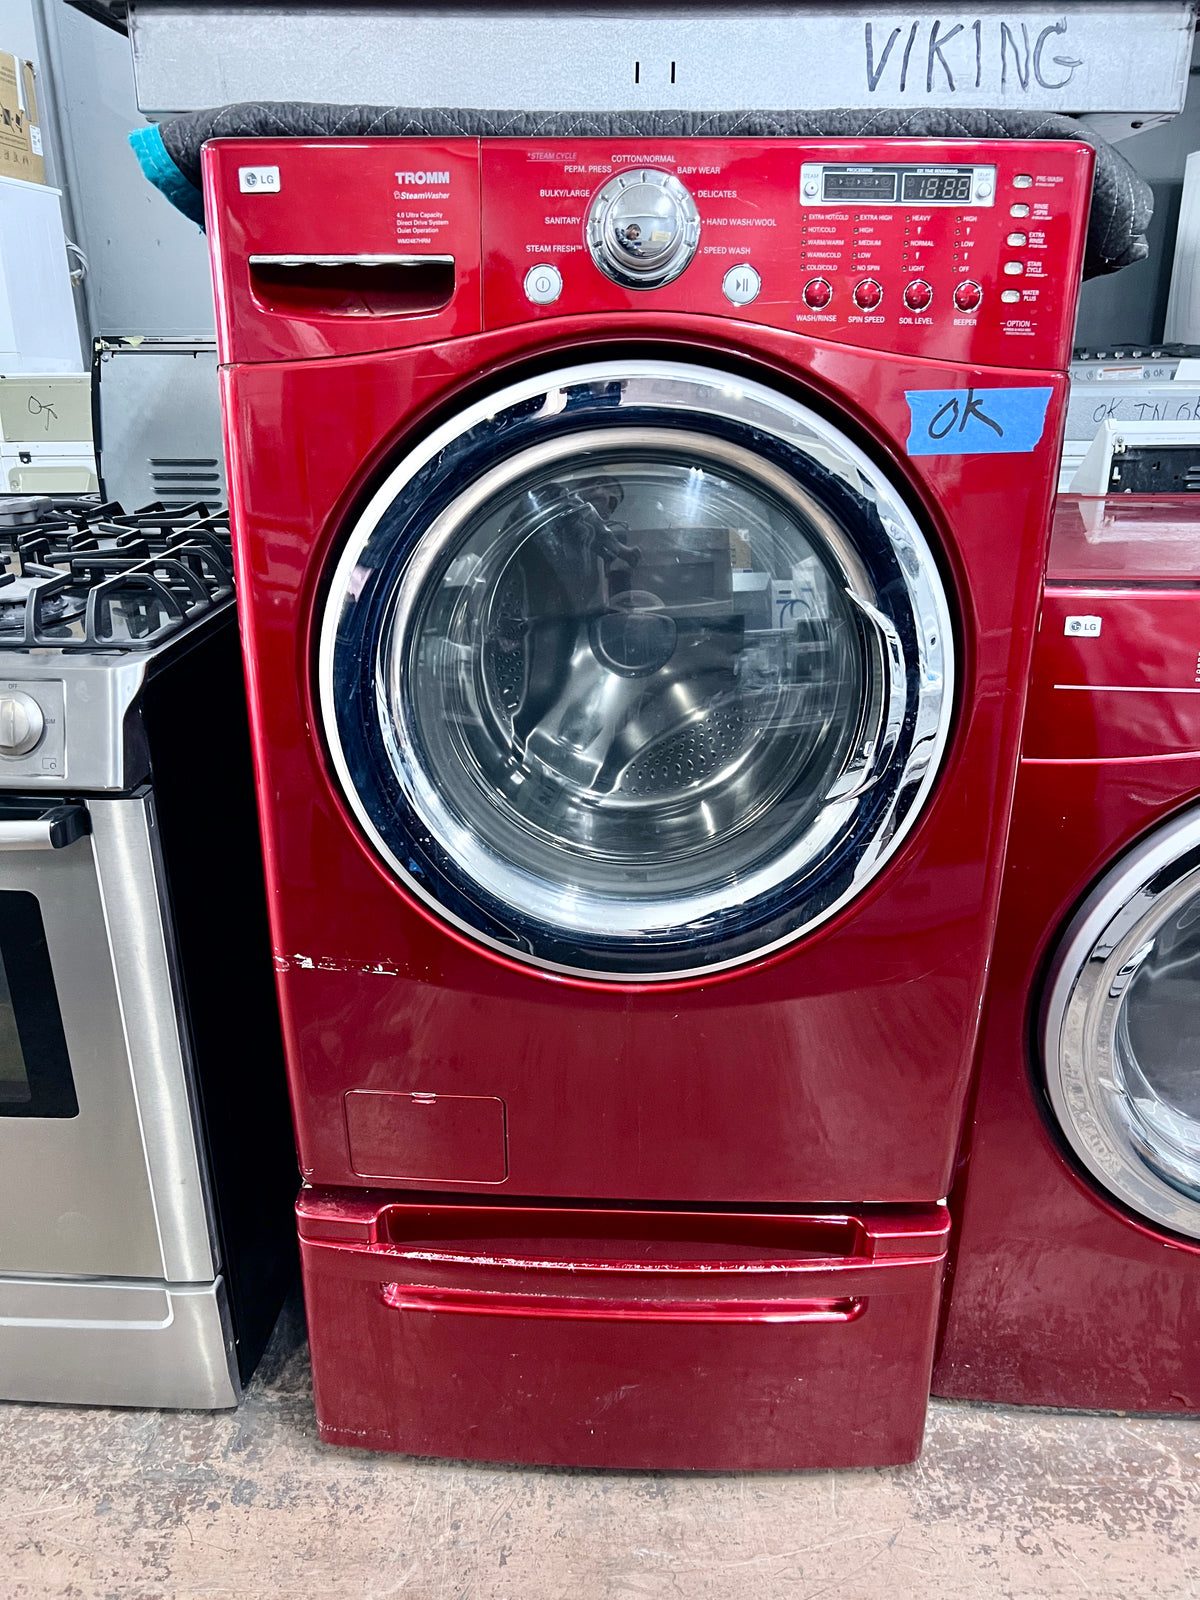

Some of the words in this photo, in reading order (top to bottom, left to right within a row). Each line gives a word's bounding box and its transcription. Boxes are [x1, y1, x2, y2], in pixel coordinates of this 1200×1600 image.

[865, 16, 1083, 93] VIKING
[556, 152, 577, 160] CYCLE
[611, 154, 676, 163] COTTON/NORMAL
[588, 165, 612, 173] PRESS
[677, 166, 697, 174] BABY
[698, 166, 721, 175] WEAR
[260, 174, 275, 185] LG
[394, 171, 450, 185] TROMM
[400, 191, 450, 200] SteamWasher
[539, 189, 590, 197] BULKY/LARGE
[697, 190, 738, 199] DELICATES
[419, 211, 443, 219] Capacity
[808, 213, 824, 221] EXTRA
[859, 213, 878, 221] EXTRA
[428, 219, 449, 227] System
[544, 216, 582, 225] SANITARY
[706, 218, 728, 226] HAND
[729, 218, 777, 227] WASH/WOOL
[412, 227, 439, 235] Operation
[525, 244, 552, 253] STEAM
[703, 246, 727, 255] SPEED
[728, 246, 751, 255] WASH
[796, 314, 837, 322] WASH/RINSE
[847, 315, 864, 323] SPIN
[863, 316, 886, 324] SPEED
[898, 317, 913, 325] SOIL
[914, 317, 934, 325] LEVEL
[953, 318, 978, 326] BEEPER
[928, 387, 1004, 440] OK
[1092, 397, 1123, 423] OK
[1084, 623, 1097, 631] LG
